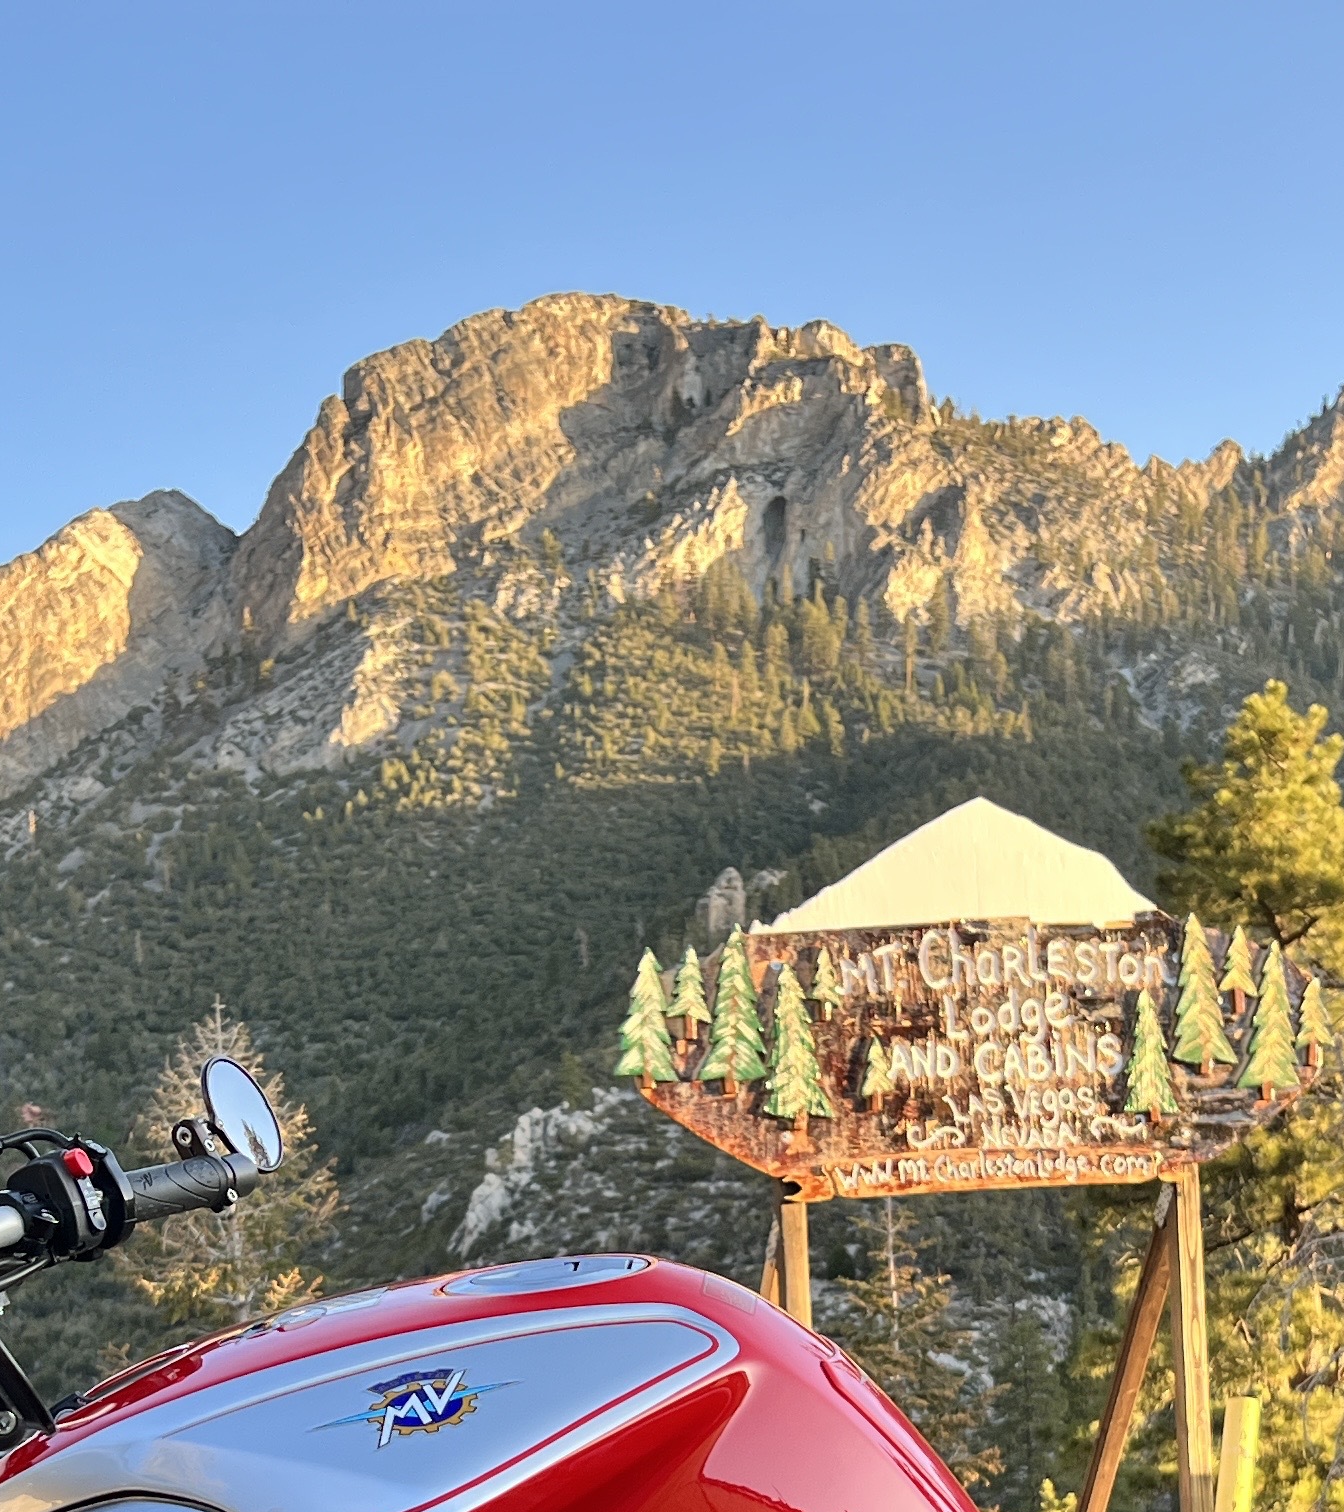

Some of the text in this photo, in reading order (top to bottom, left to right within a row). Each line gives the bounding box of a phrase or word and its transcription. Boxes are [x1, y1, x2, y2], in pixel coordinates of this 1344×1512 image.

[944, 988, 1076, 1043] Lodge
[887, 1040, 958, 1082] AND
[942, 1087, 1004, 1124] LAS
[378, 1369, 468, 1449] MV
